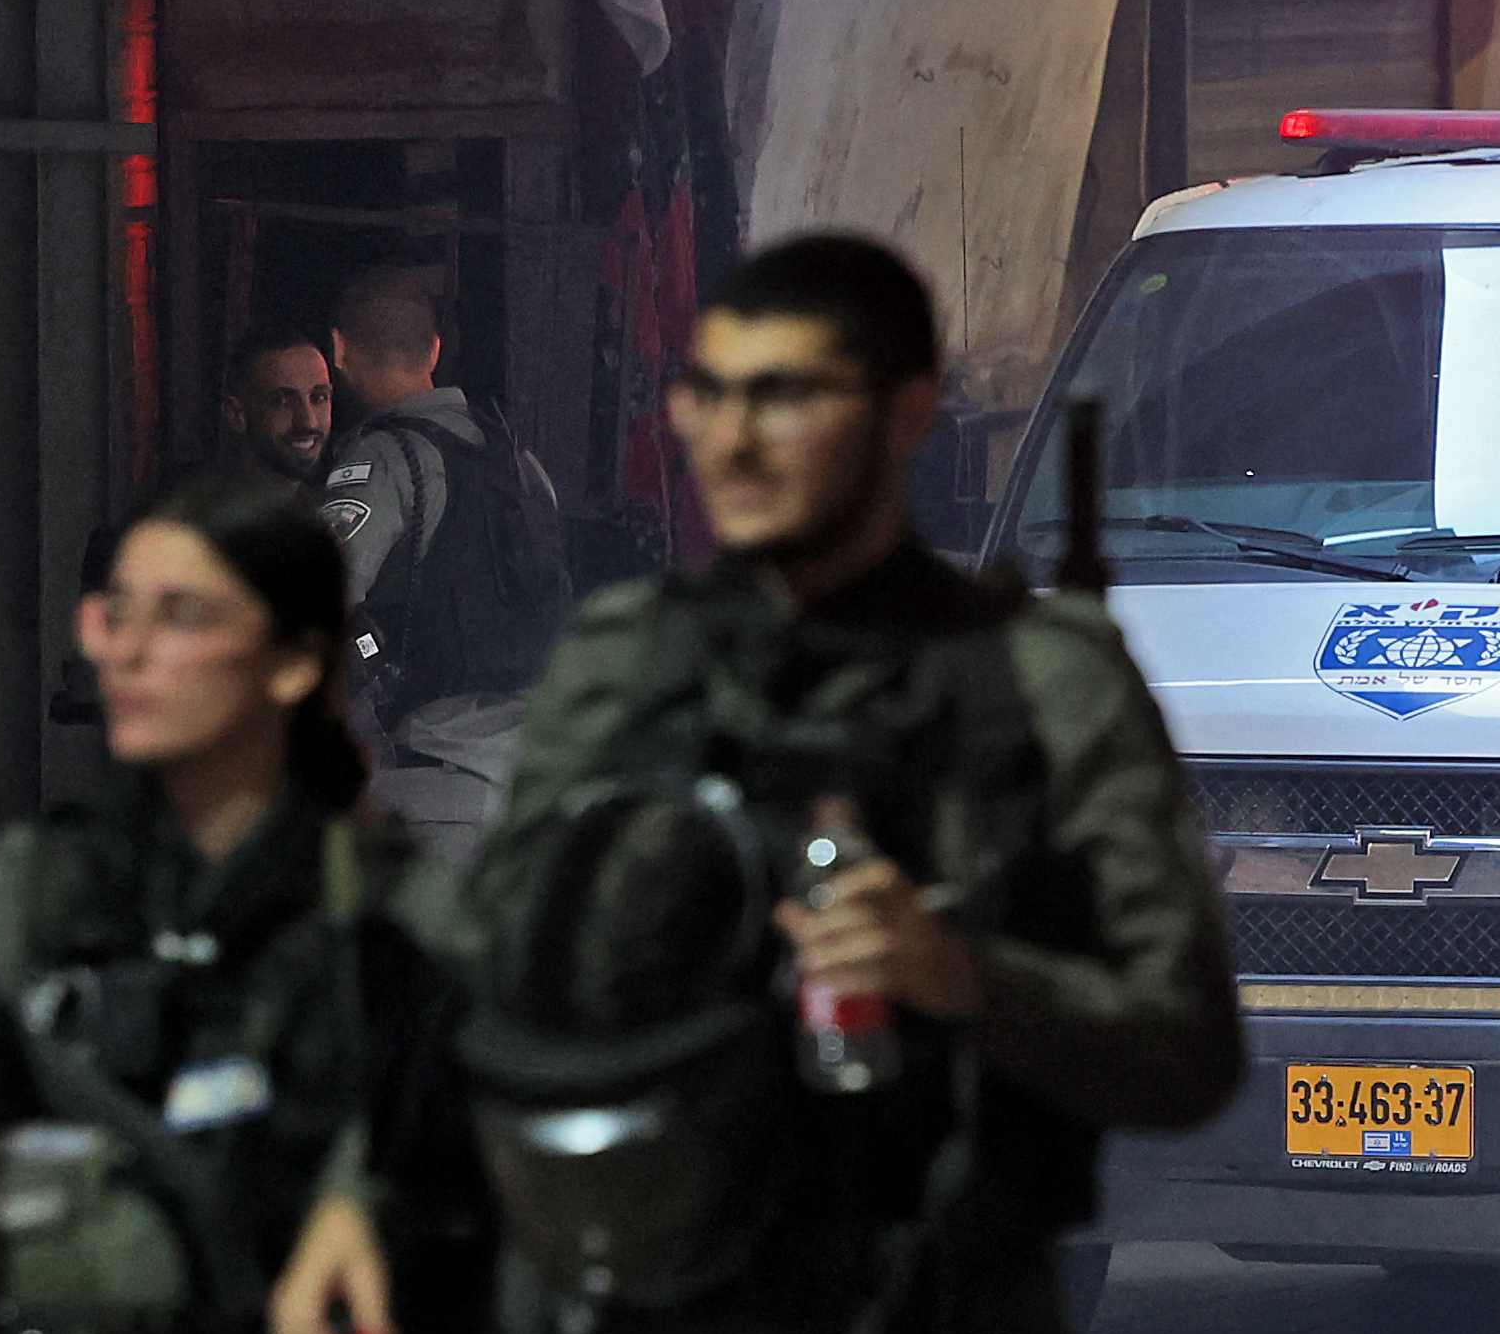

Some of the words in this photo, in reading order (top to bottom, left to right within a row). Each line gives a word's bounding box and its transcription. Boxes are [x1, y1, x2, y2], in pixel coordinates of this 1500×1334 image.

[1336, 675, 1387, 686] אמת
[1397, 671, 1429, 685] של
[1439, 676, 1482, 686] חסד
[1291, 1159, 1359, 1170] CHEVROLET
